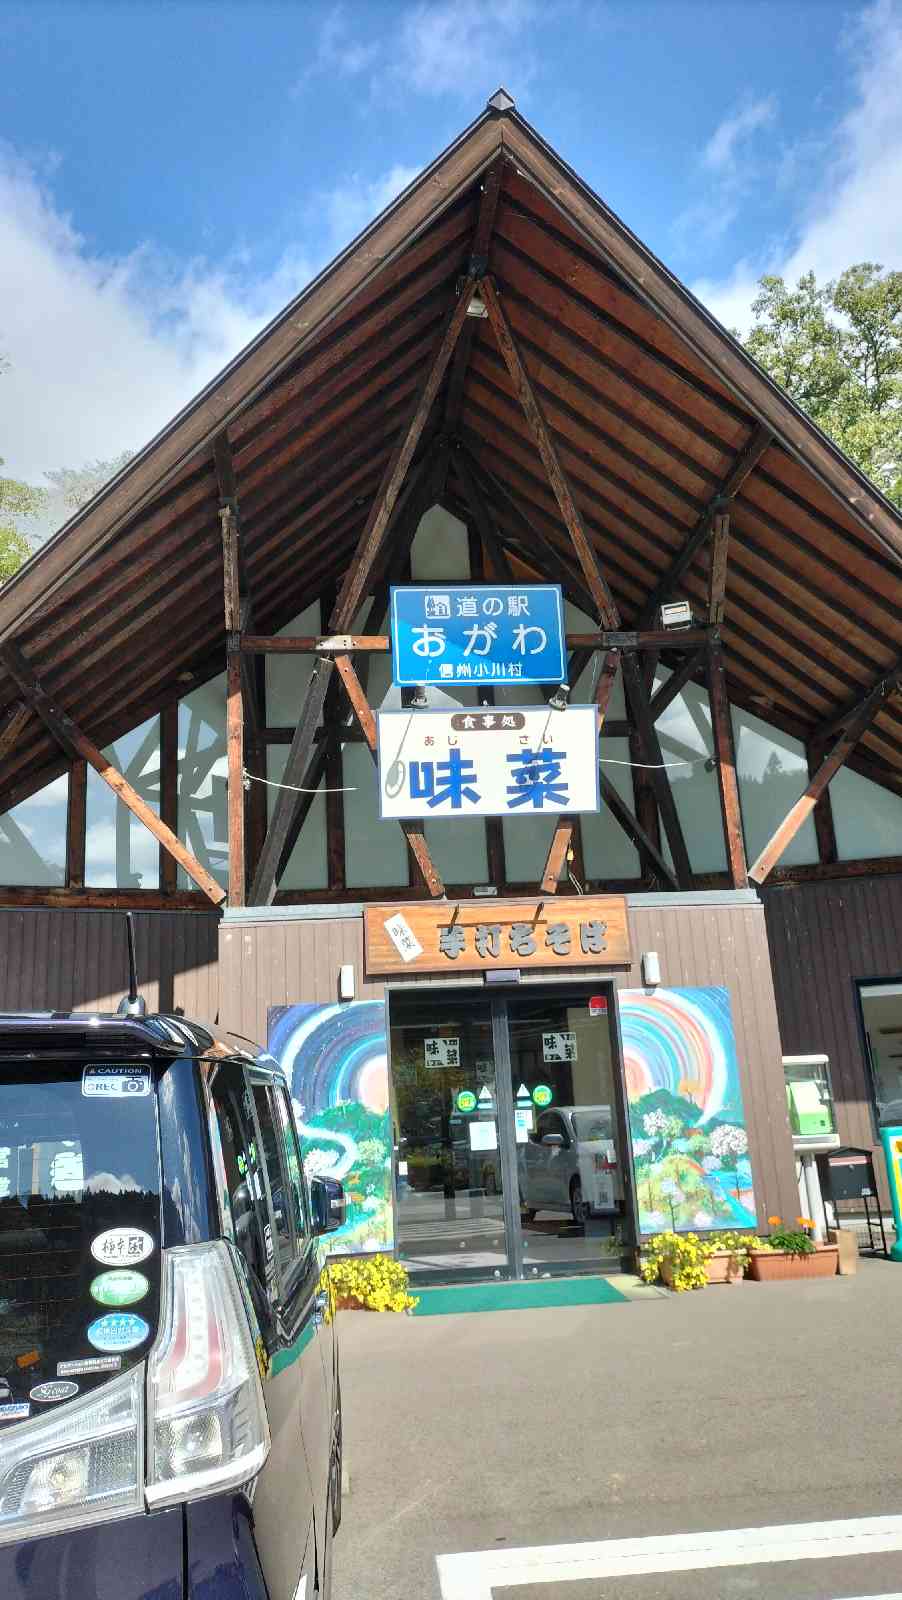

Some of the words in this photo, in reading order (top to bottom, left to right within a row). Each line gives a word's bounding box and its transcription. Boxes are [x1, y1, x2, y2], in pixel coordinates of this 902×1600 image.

[456, 595, 531, 617] 道の駅
[411, 621, 547, 657] おがわ
[439, 662, 522, 679] 信州小川村
[462, 713, 517, 729] 食事処
[424, 735, 458, 747] あじ
[519, 735, 553, 746] さい
[409, 747, 570, 809] 味菜
[95, 1083, 118, 1091] REC
